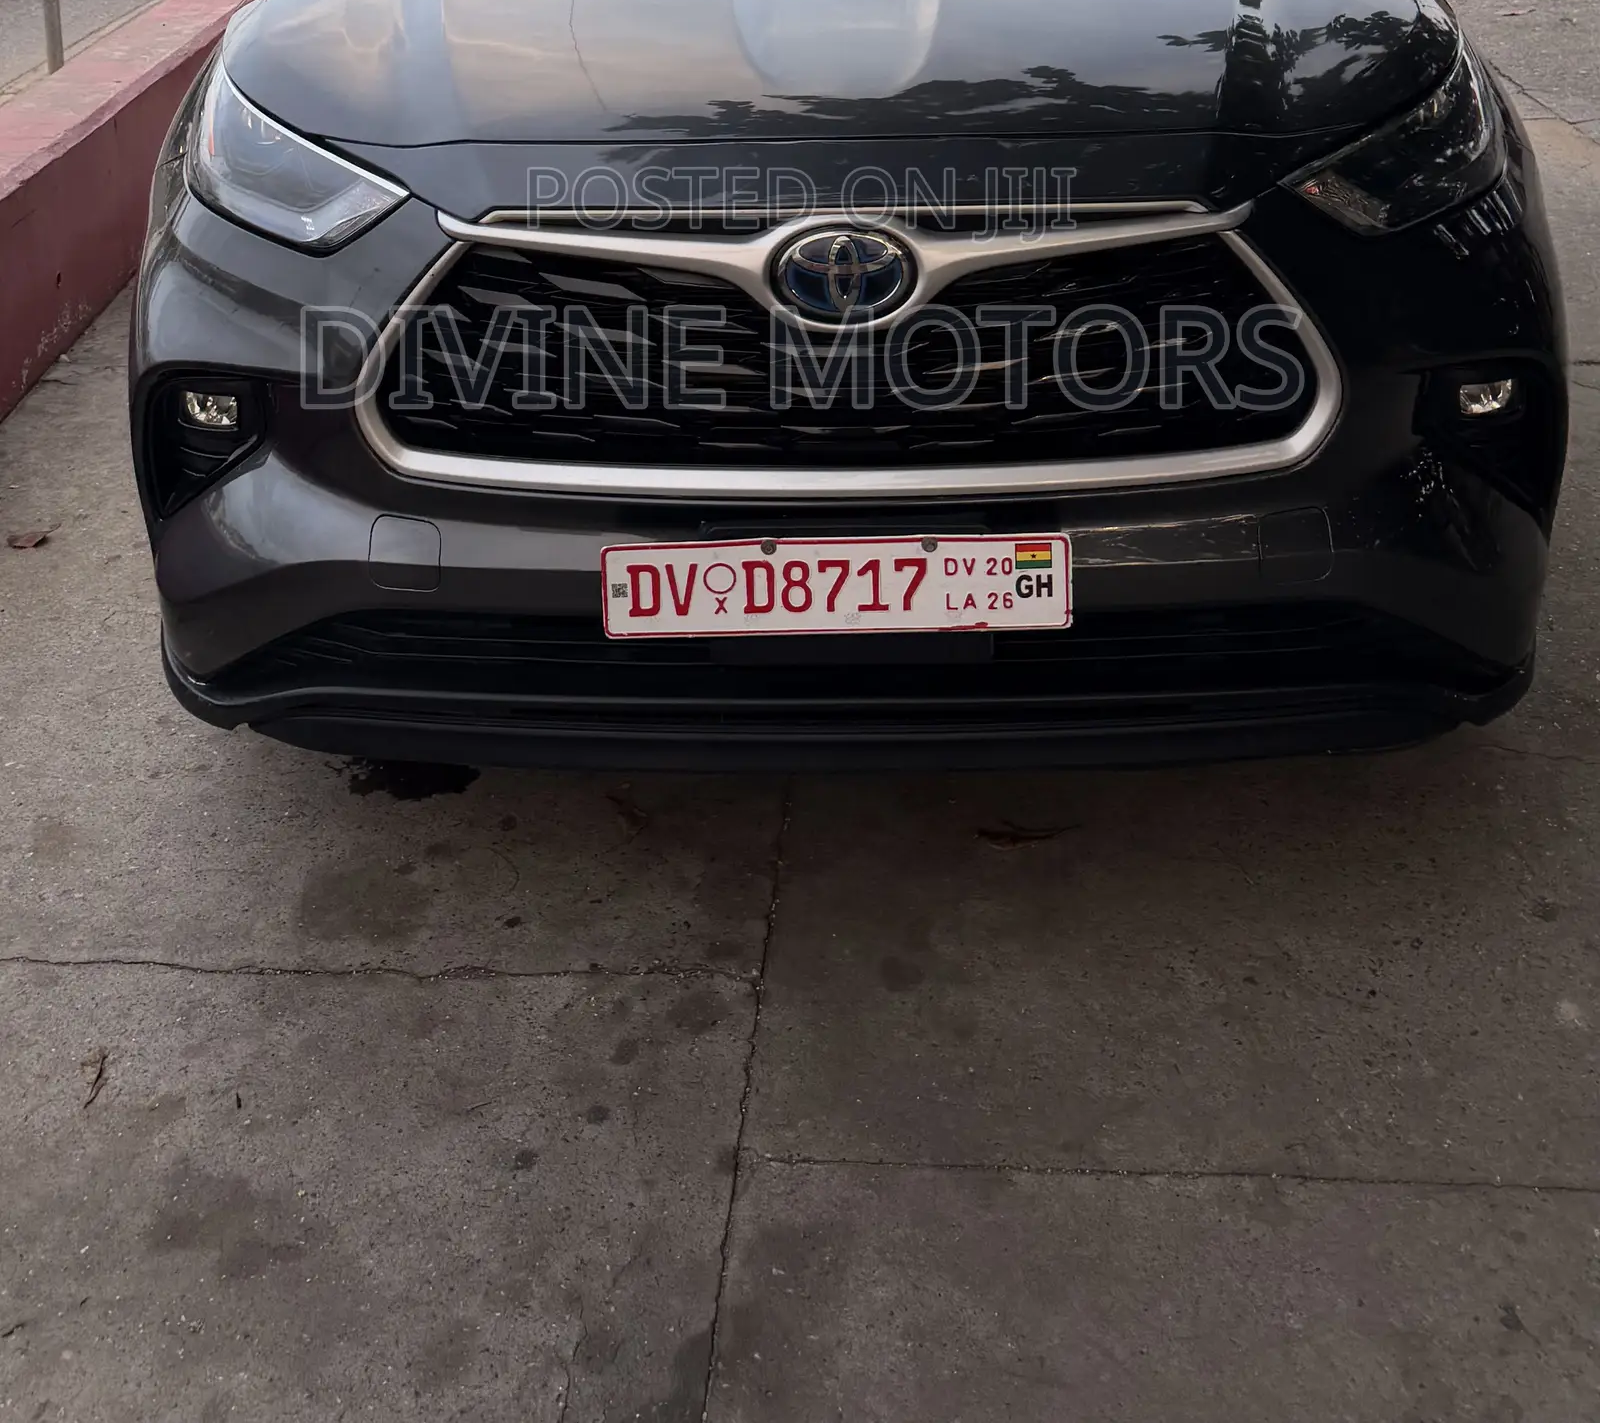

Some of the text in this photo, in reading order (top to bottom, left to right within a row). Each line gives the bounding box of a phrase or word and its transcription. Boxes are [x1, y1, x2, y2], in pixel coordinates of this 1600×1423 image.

[943, 557, 1013, 577] DV 20
[626, 563, 698, 617] DV
[741, 558, 928, 614] D8717
[1015, 574, 1053, 598] GH
[945, 591, 1014, 610] LA 26
